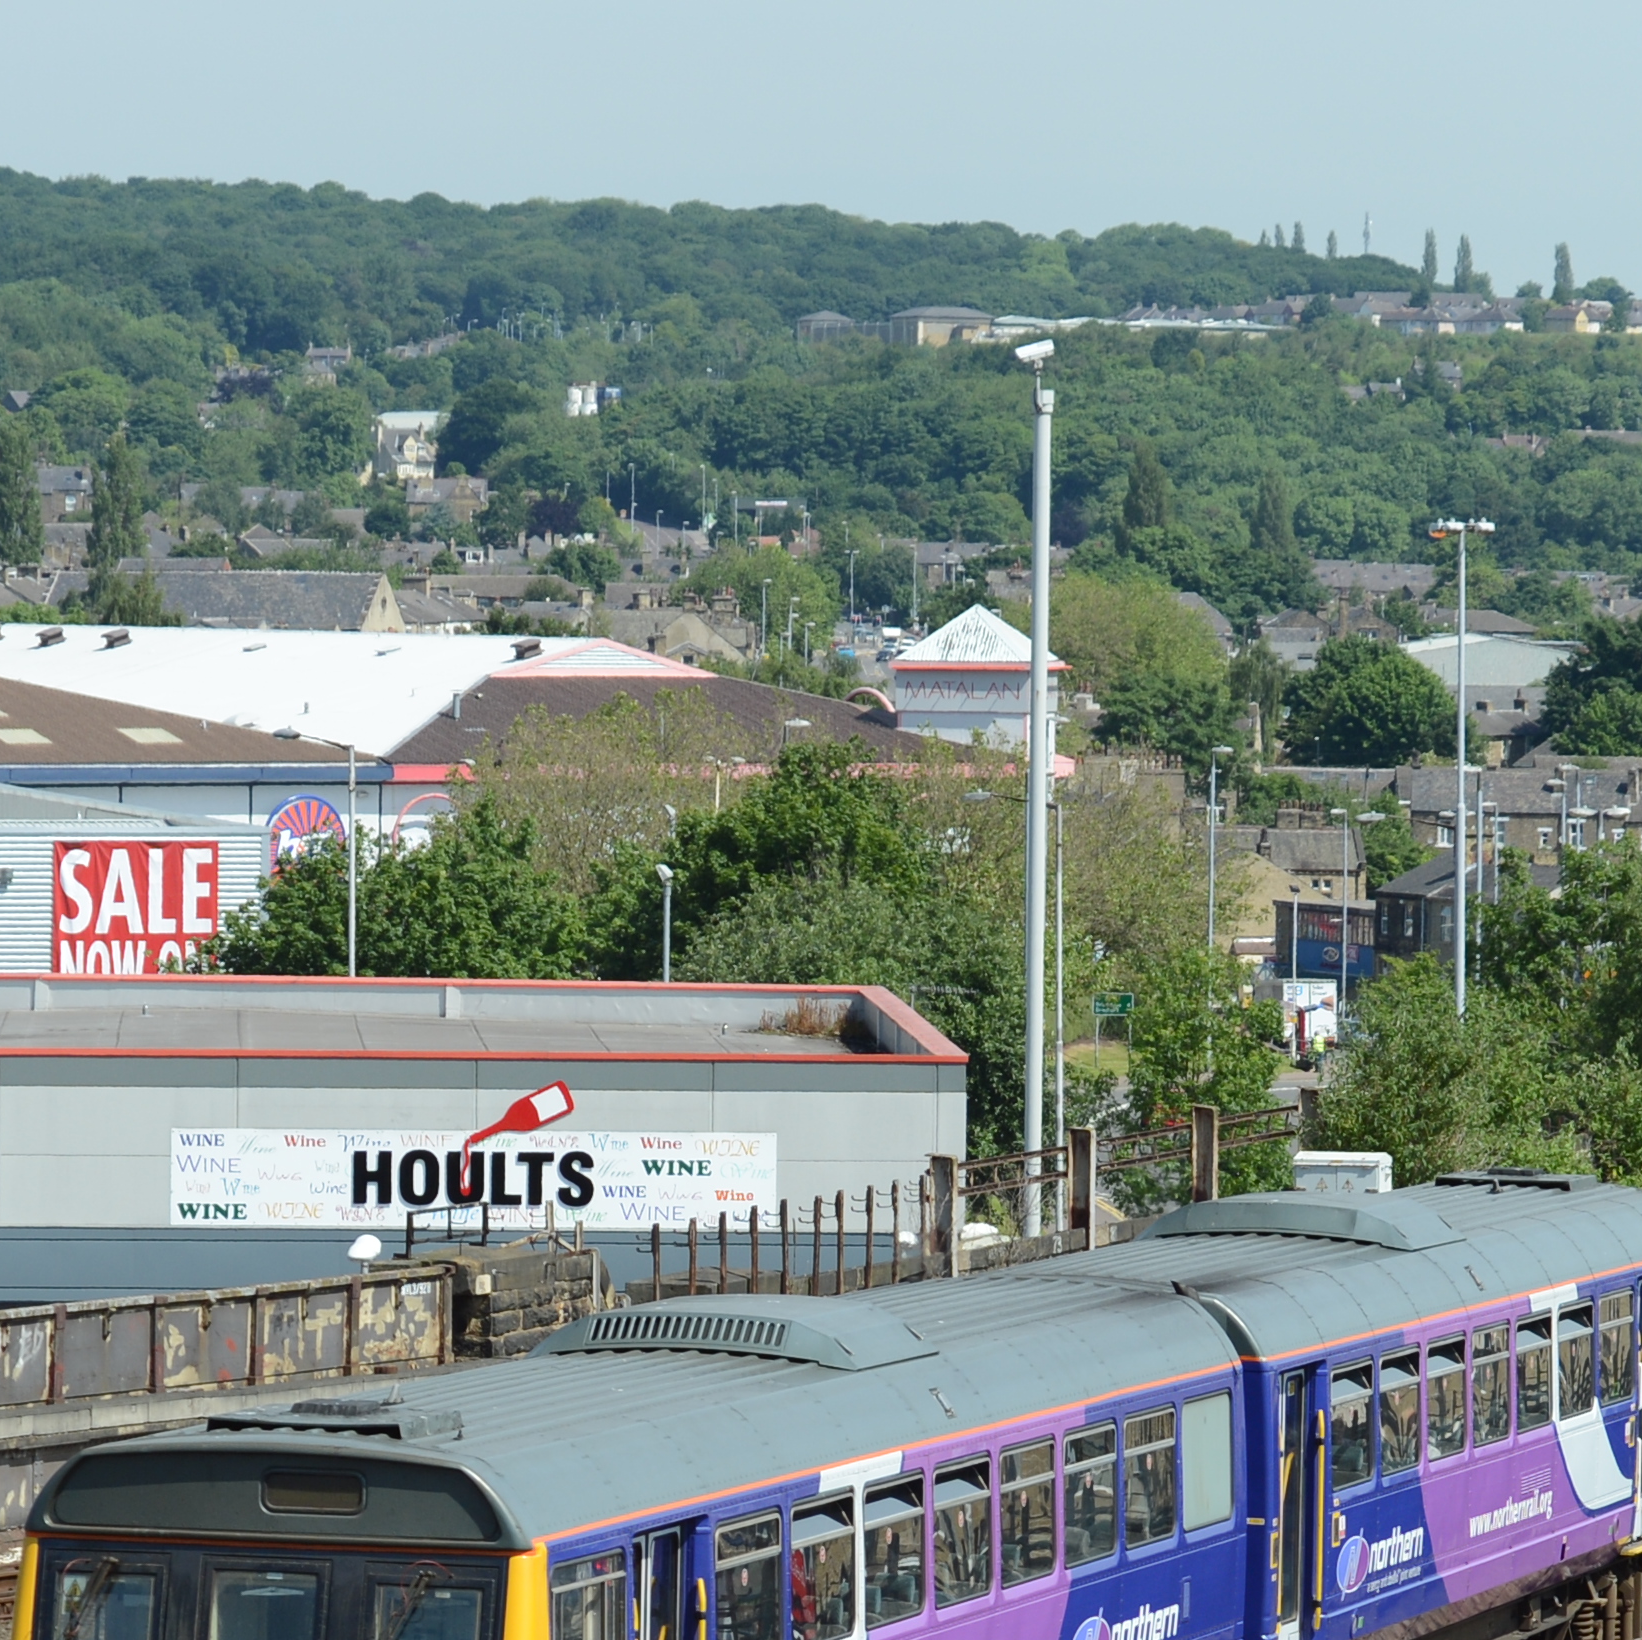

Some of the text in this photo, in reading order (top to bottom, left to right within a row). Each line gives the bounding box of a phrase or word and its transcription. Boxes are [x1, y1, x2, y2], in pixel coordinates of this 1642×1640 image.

[904, 680, 1021, 701] MATALAN
[59, 848, 213, 934] SALE
[59, 939, 147, 974] NOW
[178, 1133, 225, 1147] WINE
[284, 1134, 327, 1148] Wine
[640, 1136, 683, 1150] Wine
[641, 1159, 712, 1177] WINE
[353, 1149, 594, 1207] HOULTS
[309, 1180, 347, 1195] Wine
[601, 1185, 647, 1198] WINE
[714, 1189, 754, 1201] Wine
[177, 1202, 247, 1220] WINE
[1368, 1525, 1424, 1574] northern
